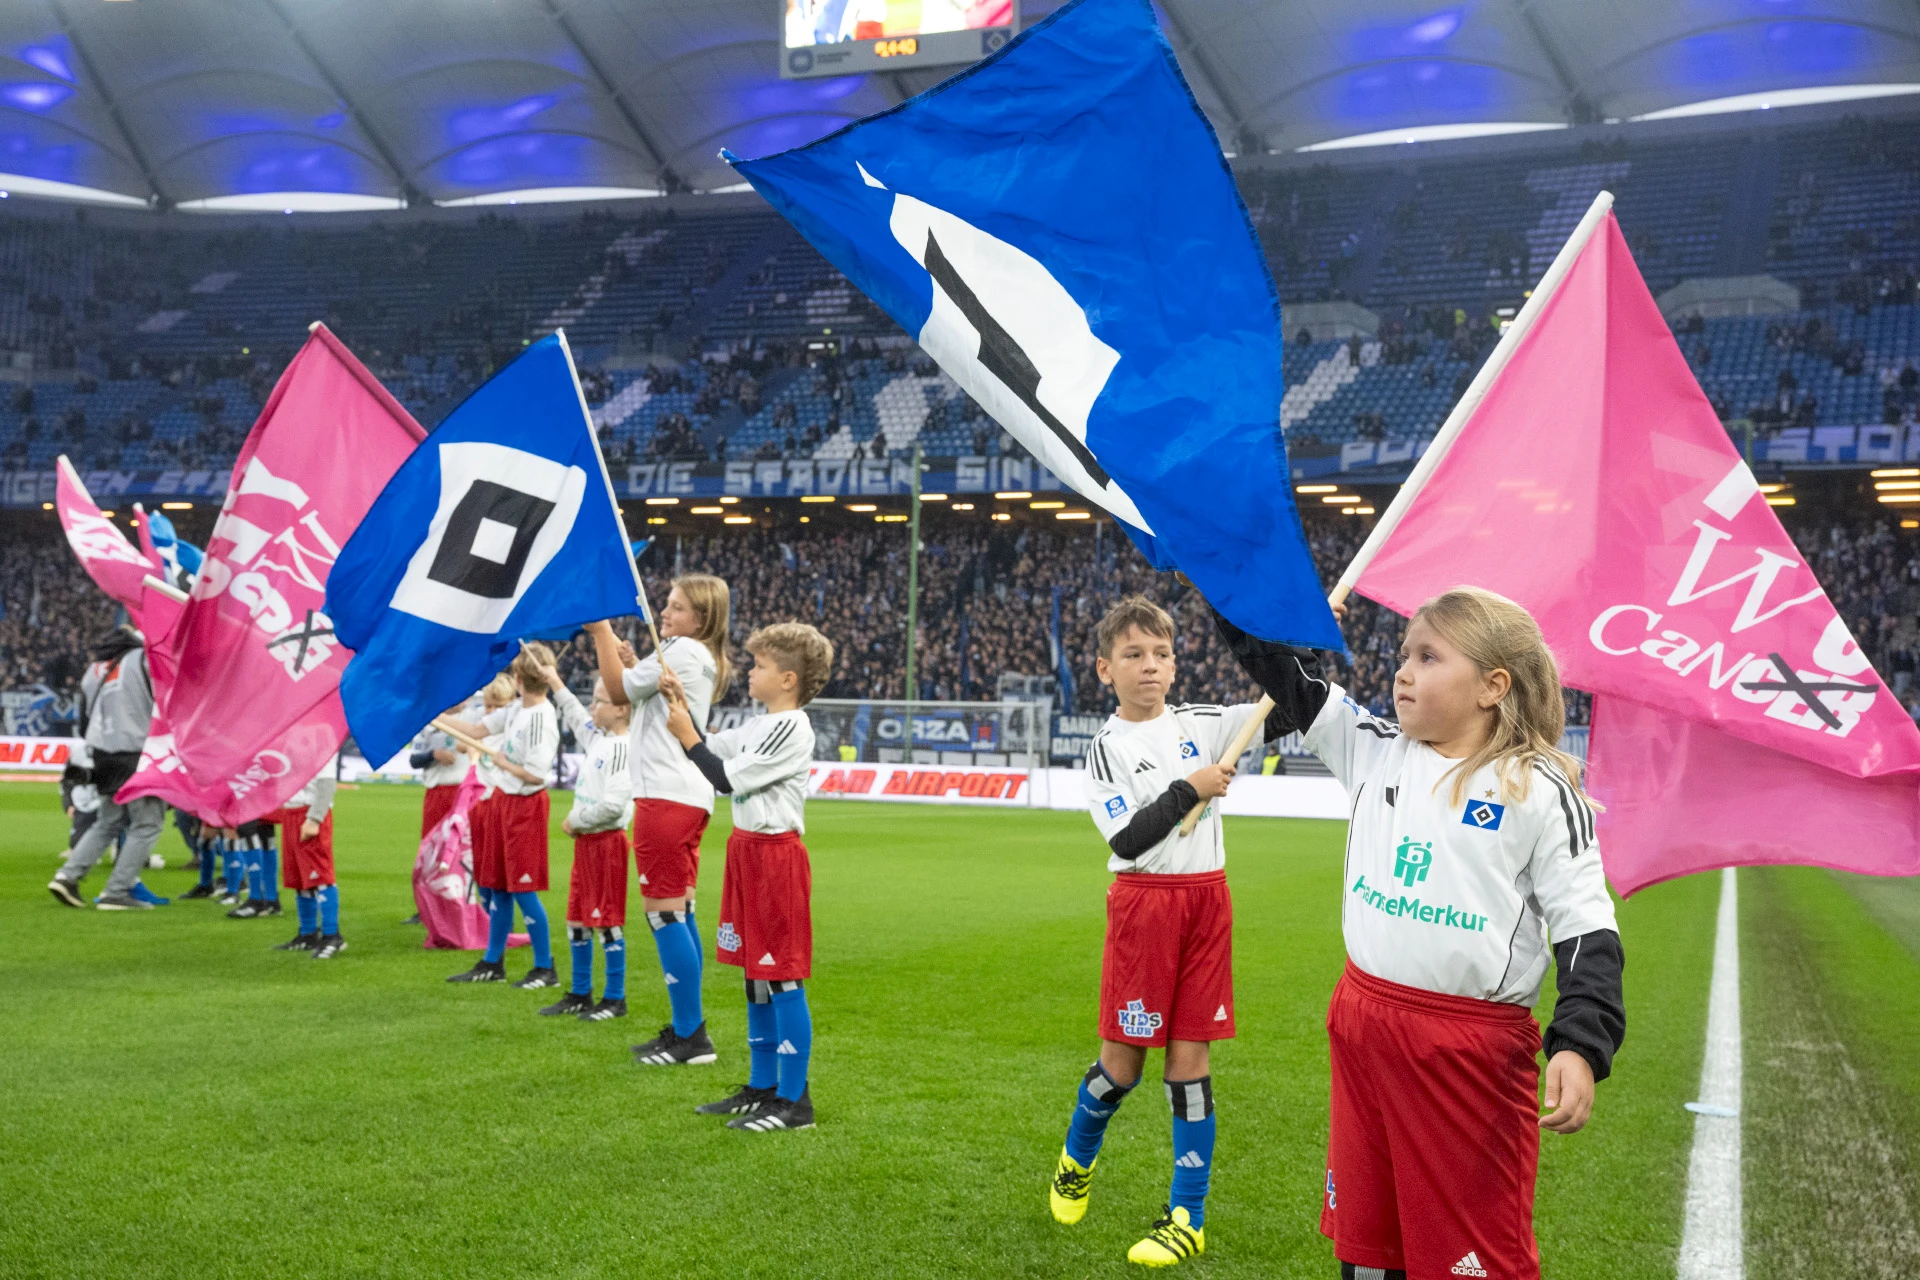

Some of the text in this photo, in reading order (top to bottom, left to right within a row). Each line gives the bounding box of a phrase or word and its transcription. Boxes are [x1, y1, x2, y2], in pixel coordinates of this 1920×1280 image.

[627, 462, 696, 494] DIE
[724, 457, 915, 496] STADIEN
[882, 770, 1028, 799] AIRPORT
[1119, 1012, 1161, 1027] KIDS
[1125, 1026, 1152, 1036] CLUB
[1451, 1267, 1487, 1278] adidas
